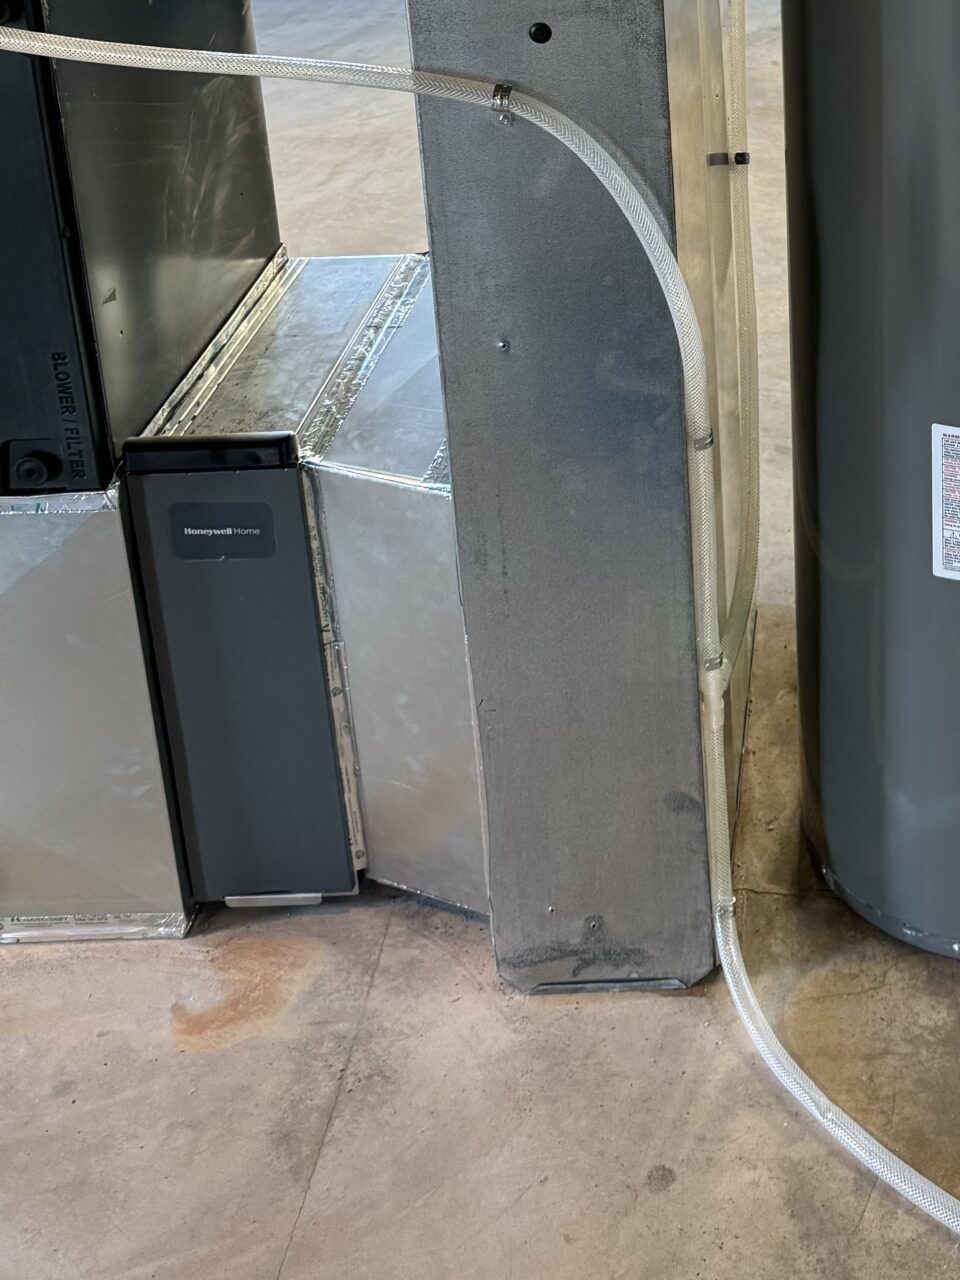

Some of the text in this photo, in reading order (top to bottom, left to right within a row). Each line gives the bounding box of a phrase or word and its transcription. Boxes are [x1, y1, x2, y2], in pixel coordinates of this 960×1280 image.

[51, 351, 77, 416] BLOWER
[64, 427, 87, 480] FILTER
[184, 528, 232, 536] Honeywell
